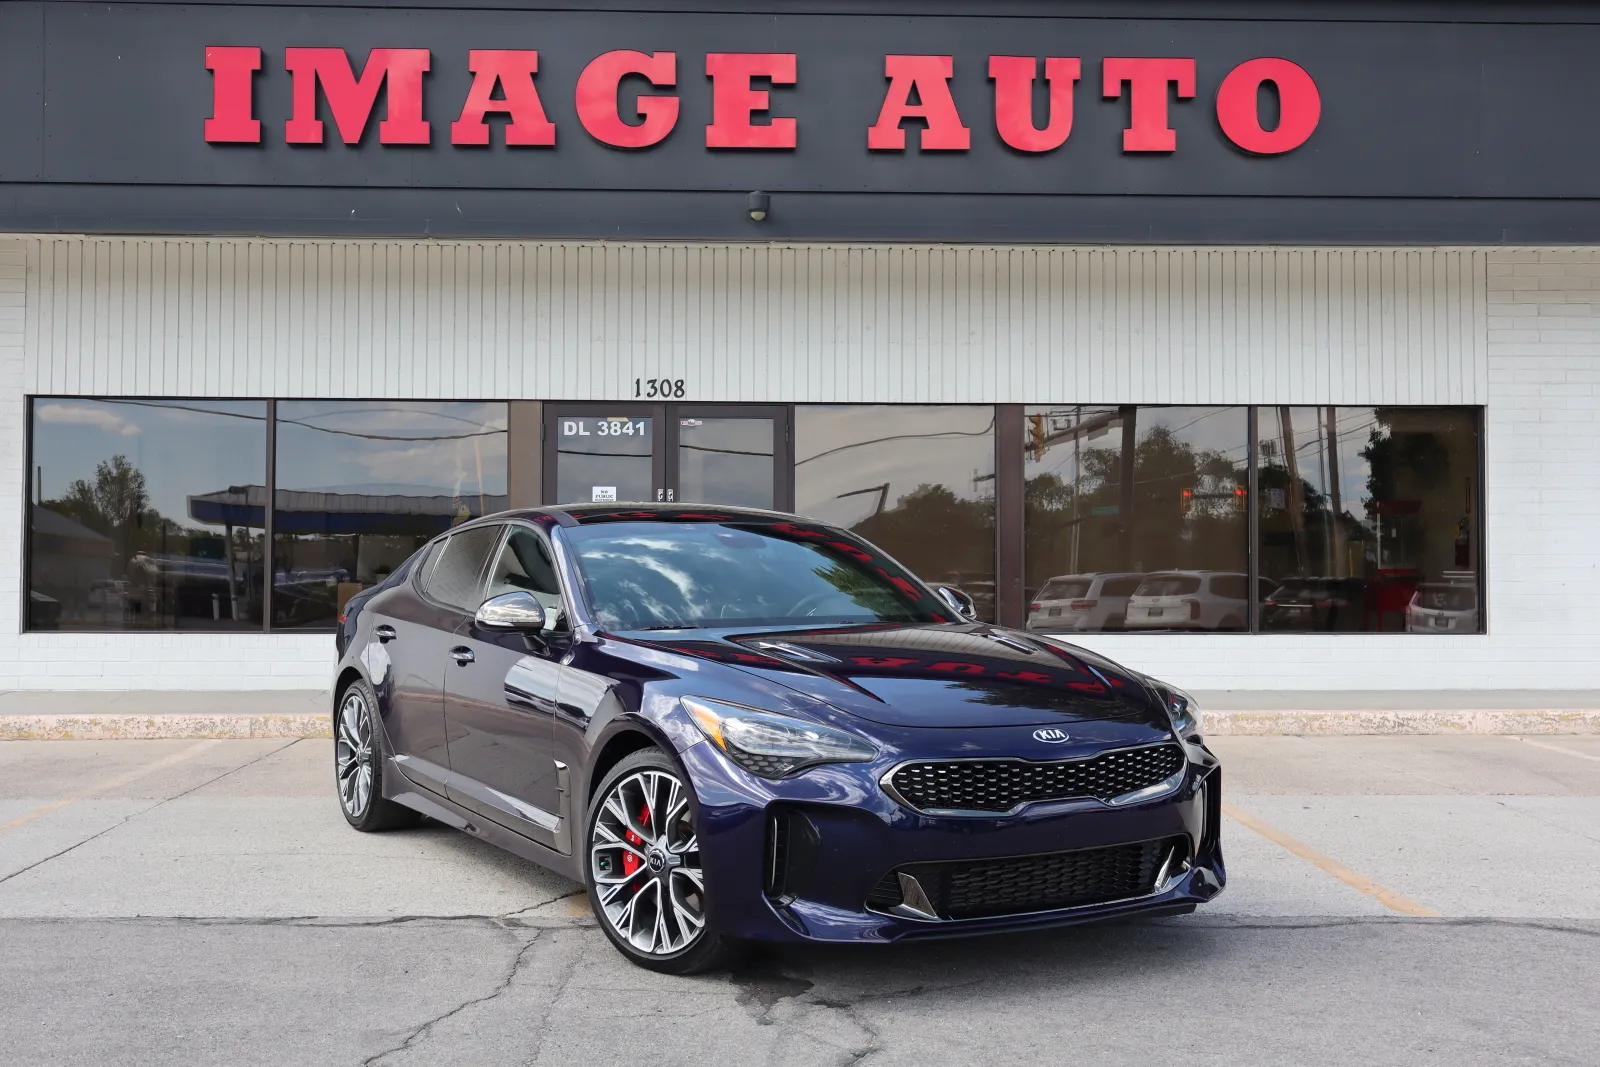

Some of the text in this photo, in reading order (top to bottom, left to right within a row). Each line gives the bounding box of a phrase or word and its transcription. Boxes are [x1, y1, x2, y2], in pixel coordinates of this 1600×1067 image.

[203, 46, 1322, 154] IMAGE AUTO
[635, 378, 685, 398] 1308
[564, 421, 645, 435] DL 3841
[1037, 729, 1066, 740] KIA
[650, 857, 661, 867] KIA
